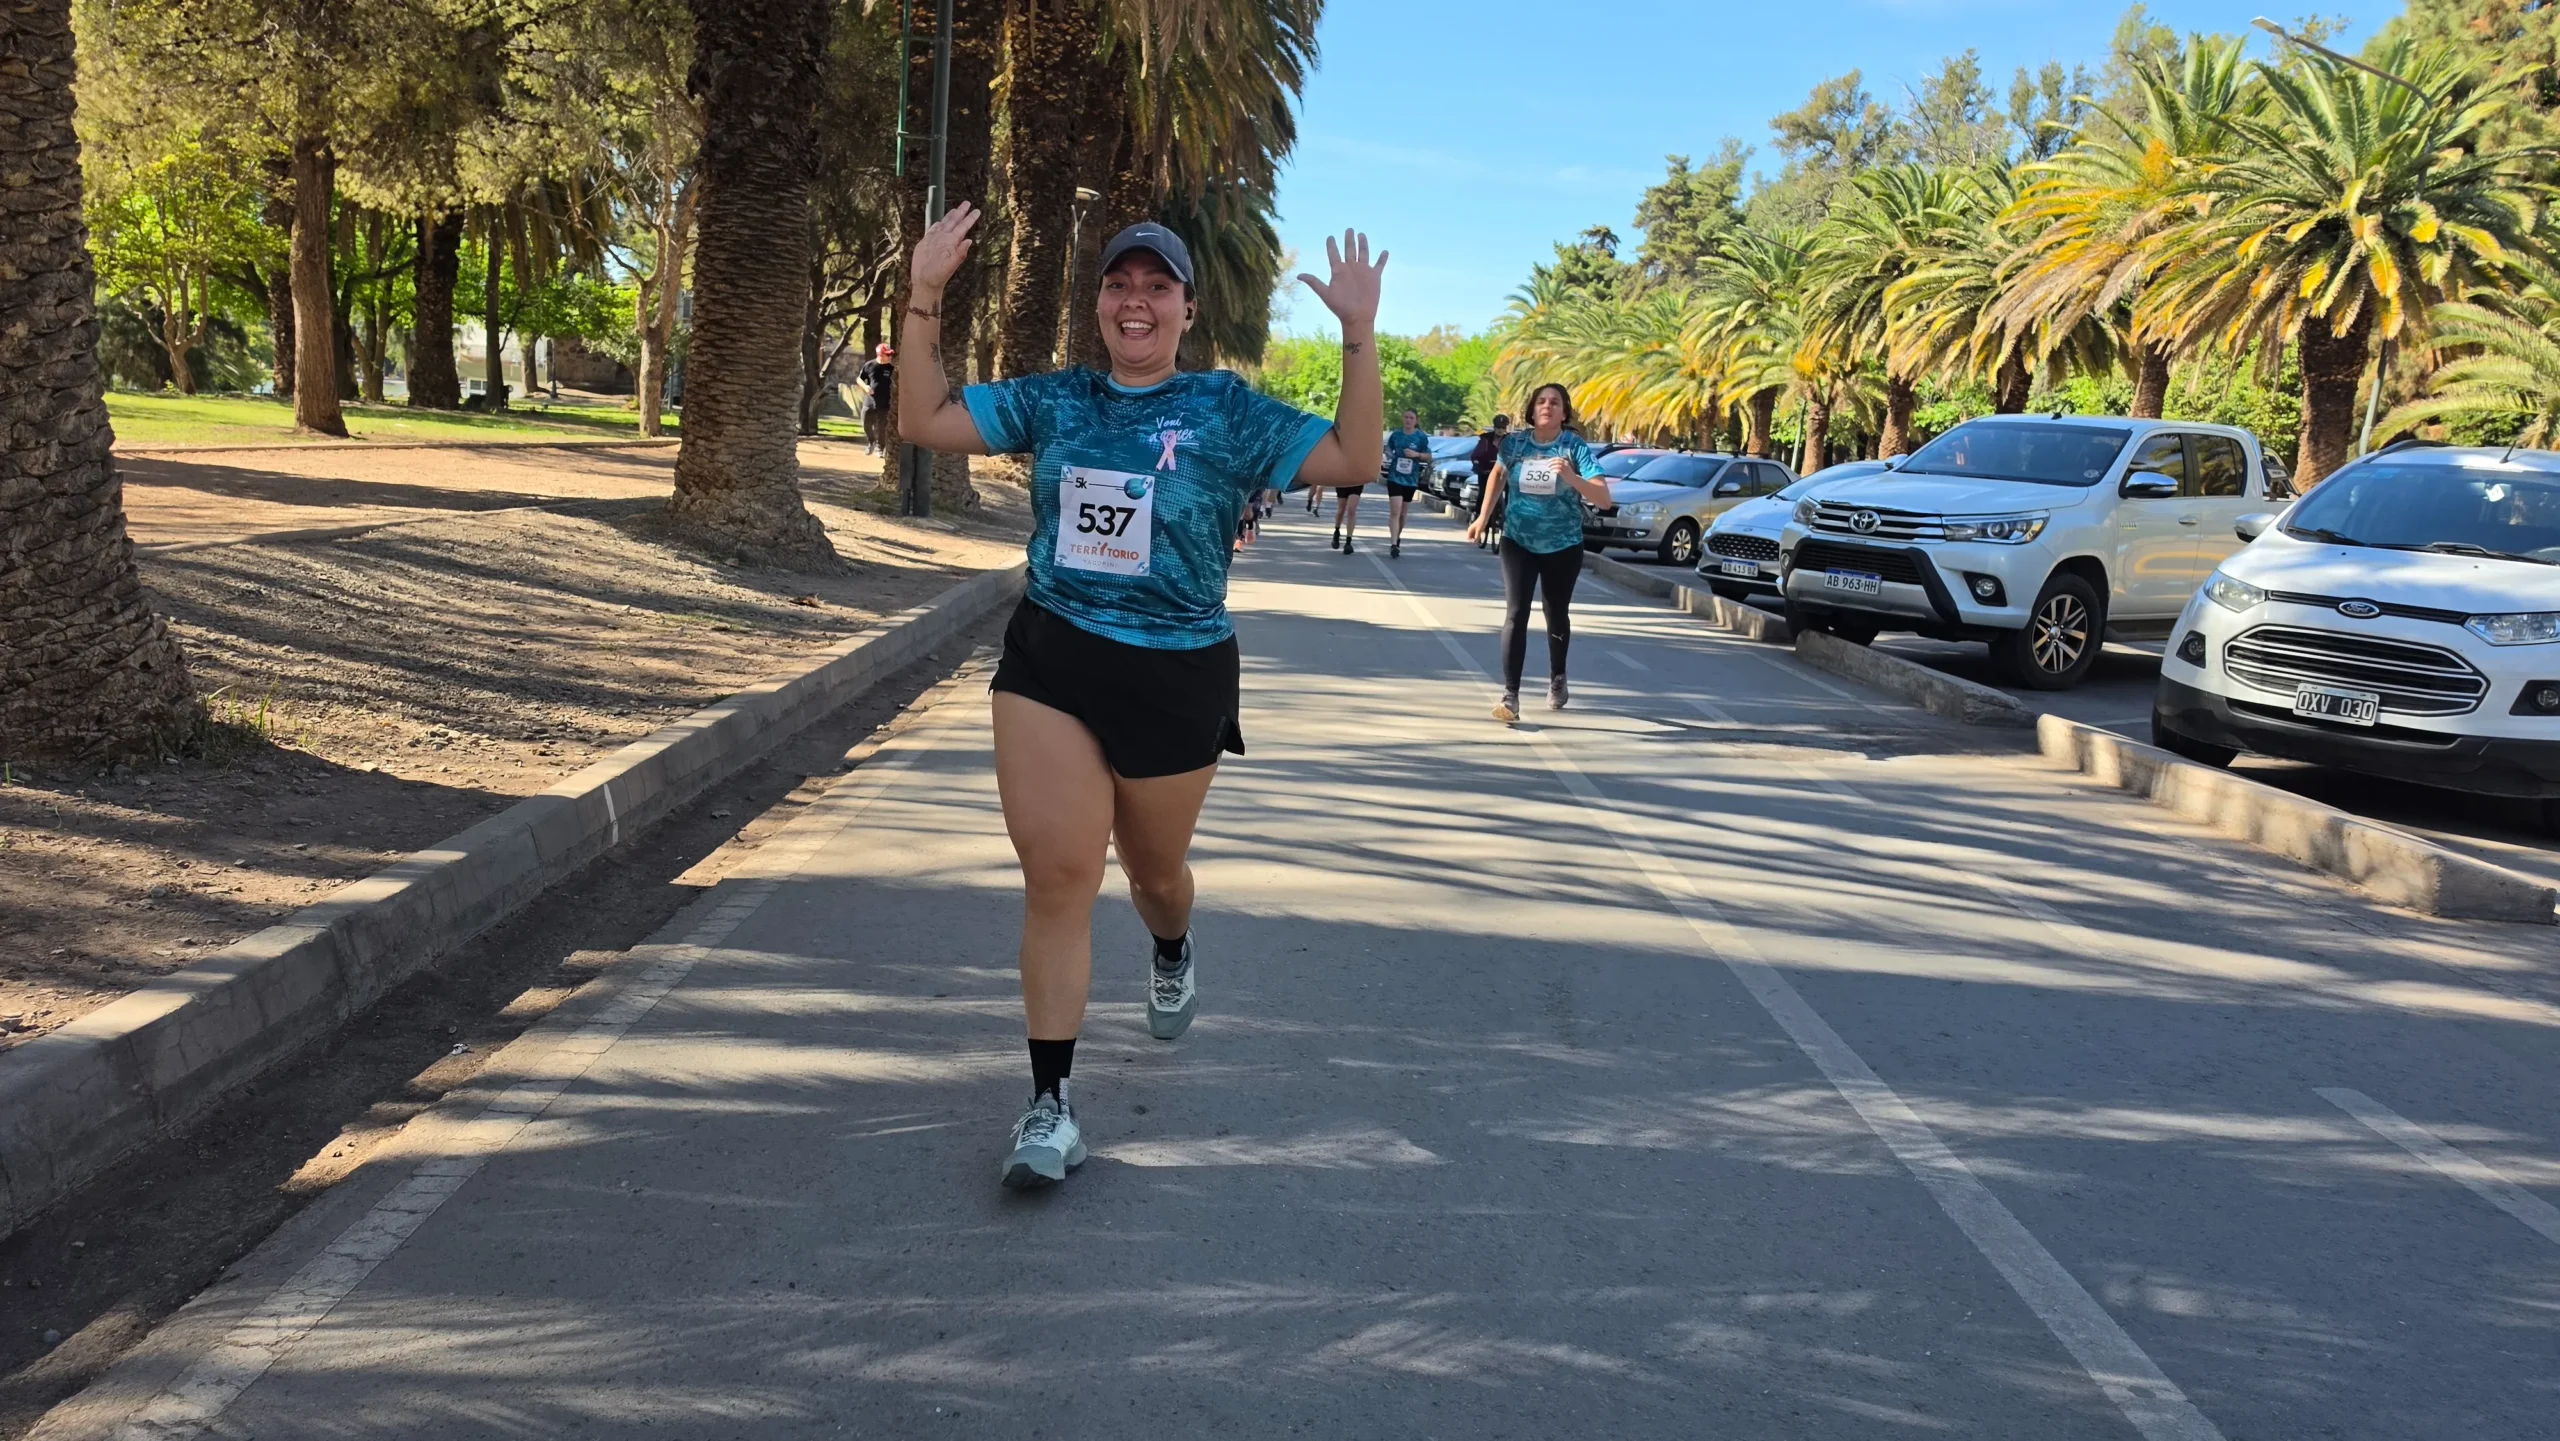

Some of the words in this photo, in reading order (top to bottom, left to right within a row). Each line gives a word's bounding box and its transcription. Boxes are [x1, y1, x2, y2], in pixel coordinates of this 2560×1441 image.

[1075, 477, 1087, 490] 5k
[1526, 470, 1551, 482] 536
[1076, 502, 1138, 538] 537
[1827, 575, 1840, 587] AB
[1842, 577, 1862, 590] 963
[1863, 580, 1878, 593] HH
[2297, 691, 2331, 713] OXV
[2340, 698, 2375, 720] 030
